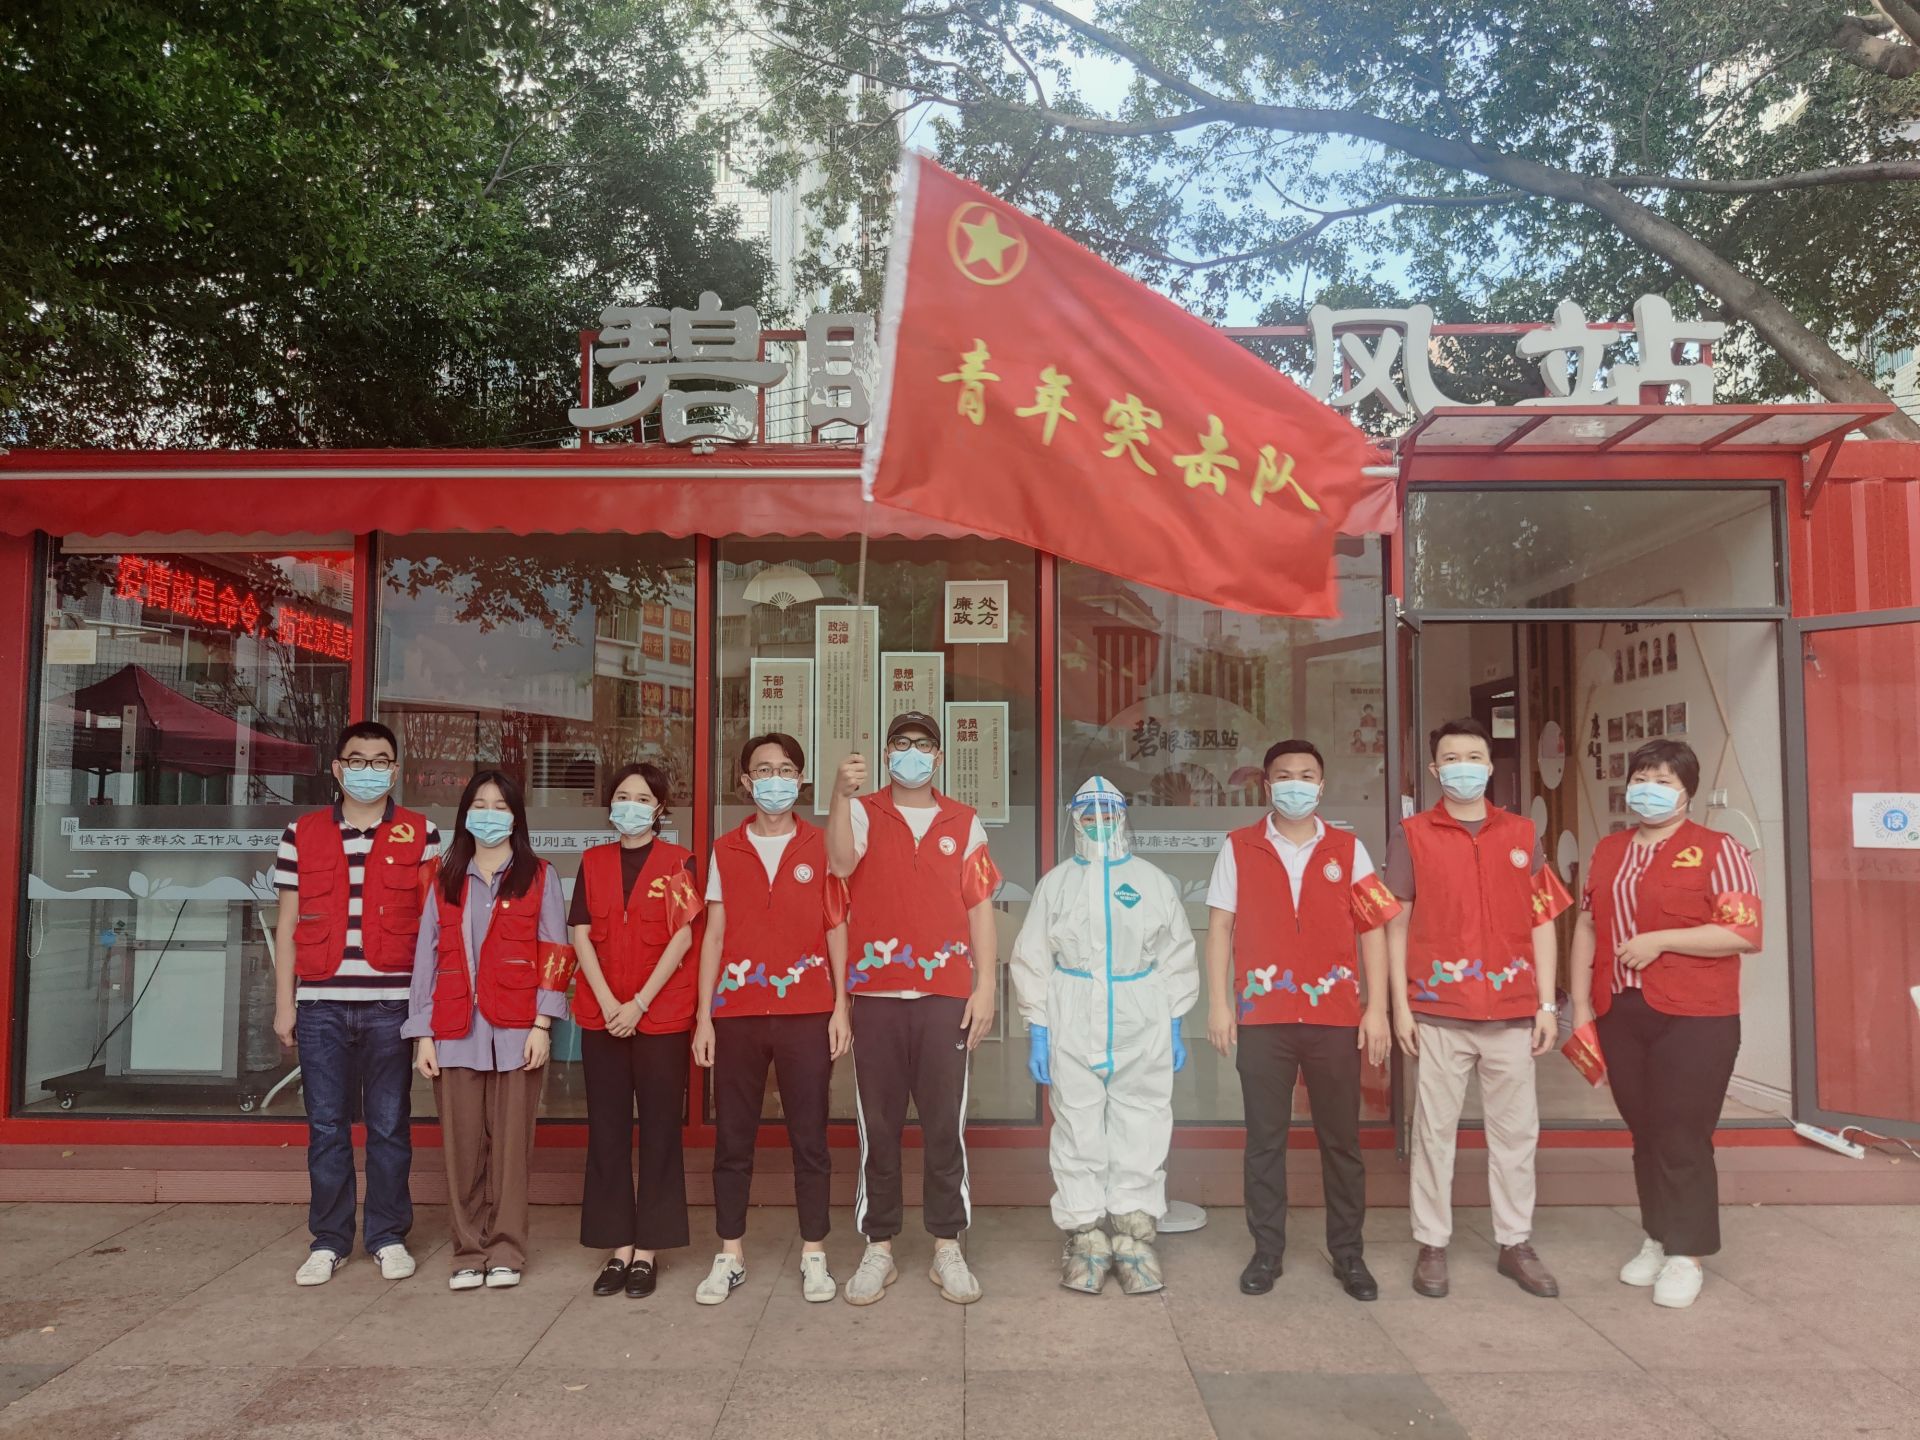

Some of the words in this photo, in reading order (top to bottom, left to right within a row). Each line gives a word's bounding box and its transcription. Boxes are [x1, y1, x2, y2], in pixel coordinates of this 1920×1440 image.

[937, 338, 1321, 512] 青年突击队
[828, 621, 848, 632] 政治
[828, 633, 848, 644] 纪律
[893, 668, 914, 680] 思想
[762, 675, 784, 686] 干部
[762, 688, 784, 699] 规范
[957, 718, 978, 729] 党员
[957, 731, 978, 742] 规范
[79, 834, 130, 846] 慎言行
[135, 834, 186, 846] 亲群众
[191, 834, 242, 846] 正作风
